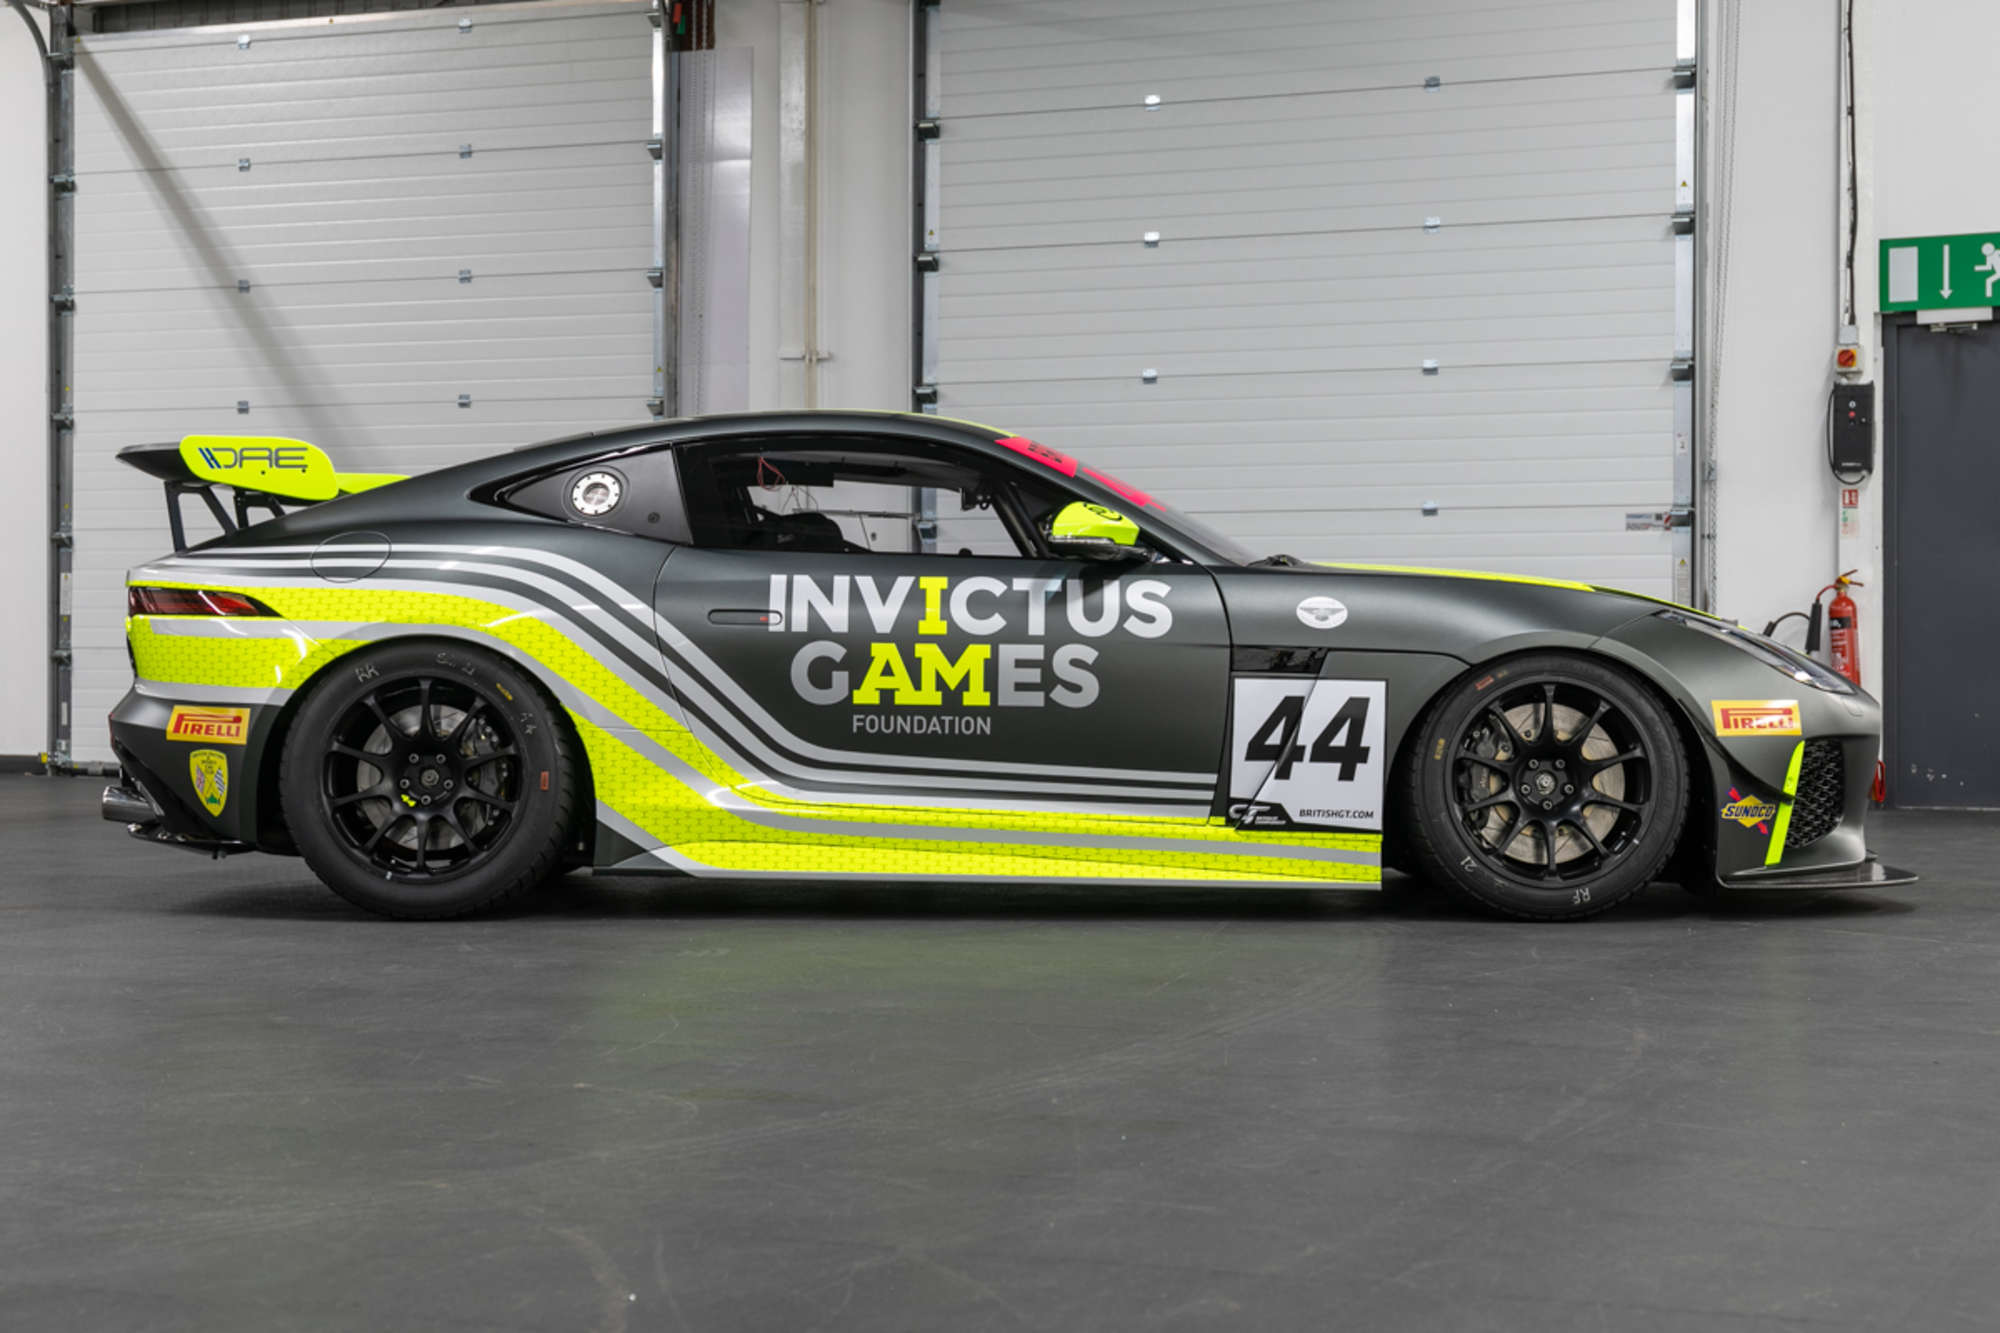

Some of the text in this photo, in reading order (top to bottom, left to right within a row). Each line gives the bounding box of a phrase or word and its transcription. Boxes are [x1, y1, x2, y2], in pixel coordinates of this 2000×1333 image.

[768, 574, 1173, 639] INVICTUS
[790, 640, 1101, 709] GAMES
[172, 713, 243, 738] PIRELLI
[852, 714, 992, 736] FOUNDATION
[1244, 695, 1371, 782] 44
[1299, 809, 1375, 820] BRITISHGT.COM
[1724, 805, 1776, 819] SUNOCO
